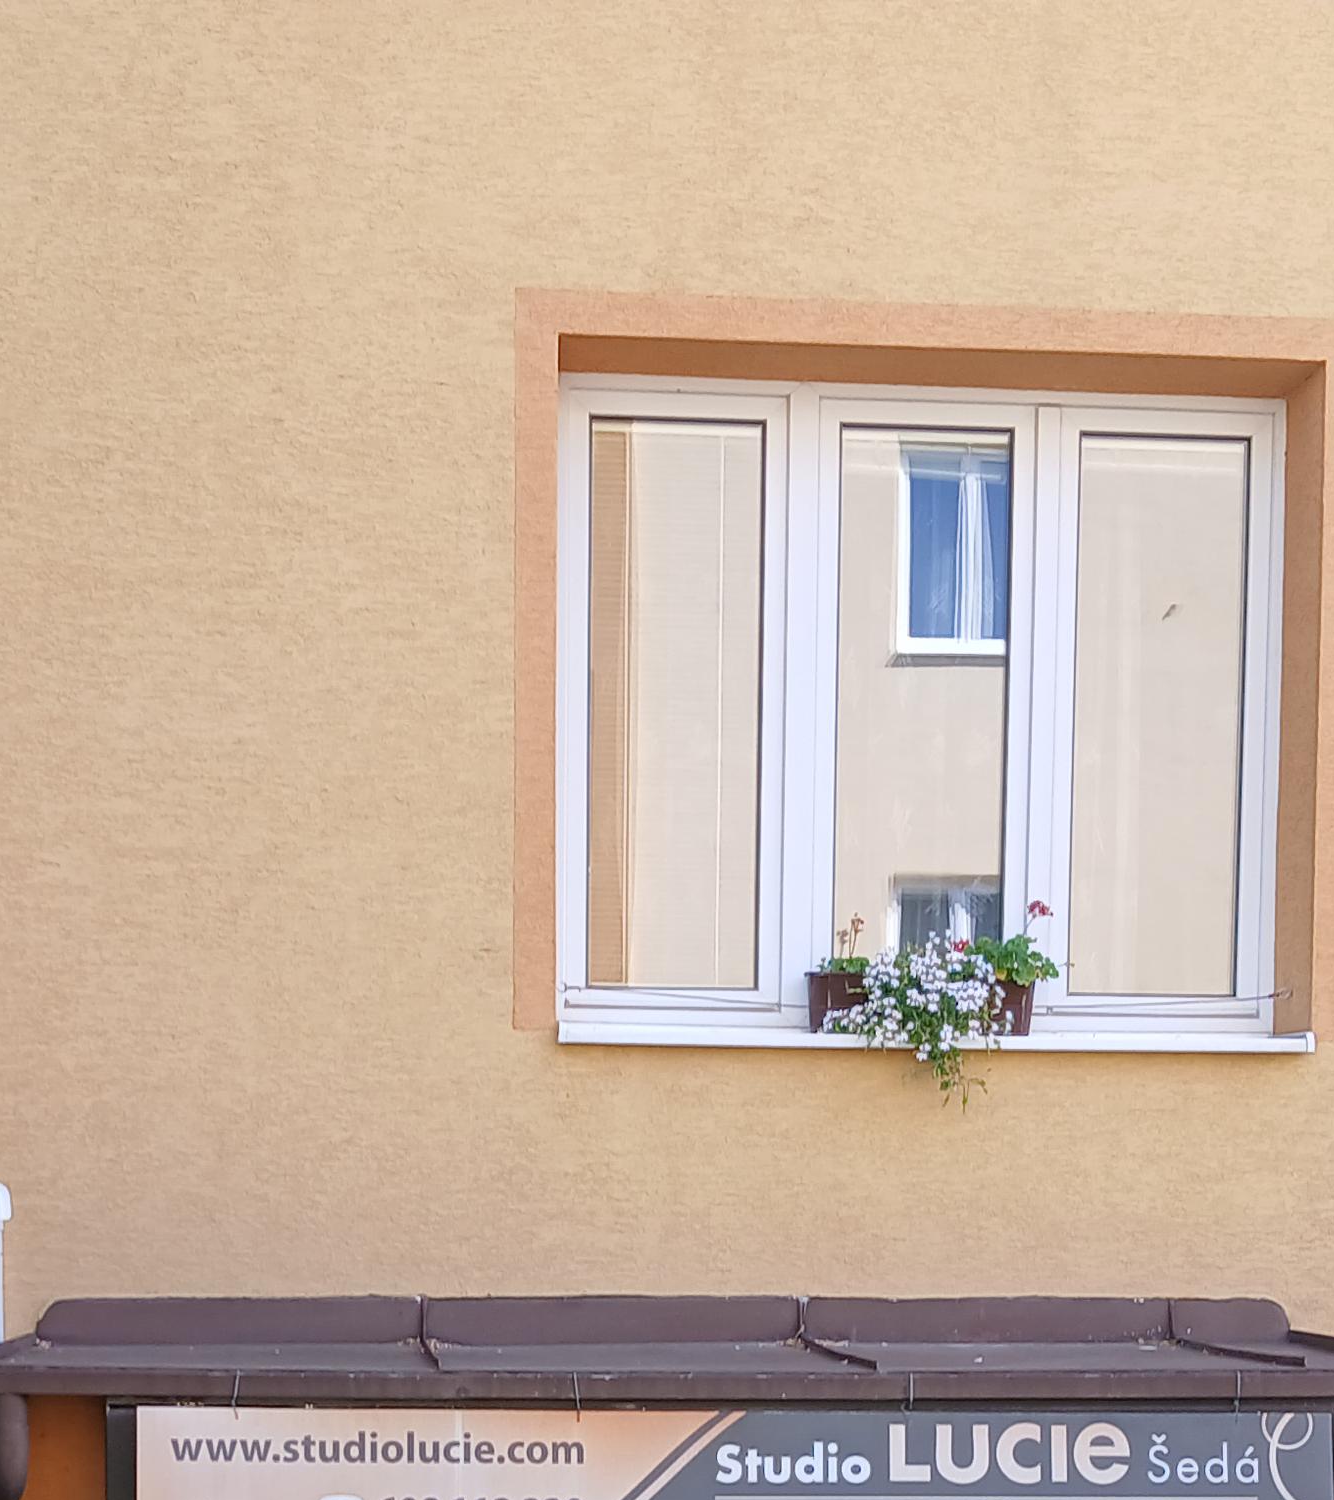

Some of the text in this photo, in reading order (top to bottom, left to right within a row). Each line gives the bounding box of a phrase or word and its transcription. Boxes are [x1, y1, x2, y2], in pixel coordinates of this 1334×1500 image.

[170, 1430, 586, 1465] www.studiolucie.com
[715, 1440, 871, 1485] Studio
[1146, 1433, 1261, 1485] Šedá
